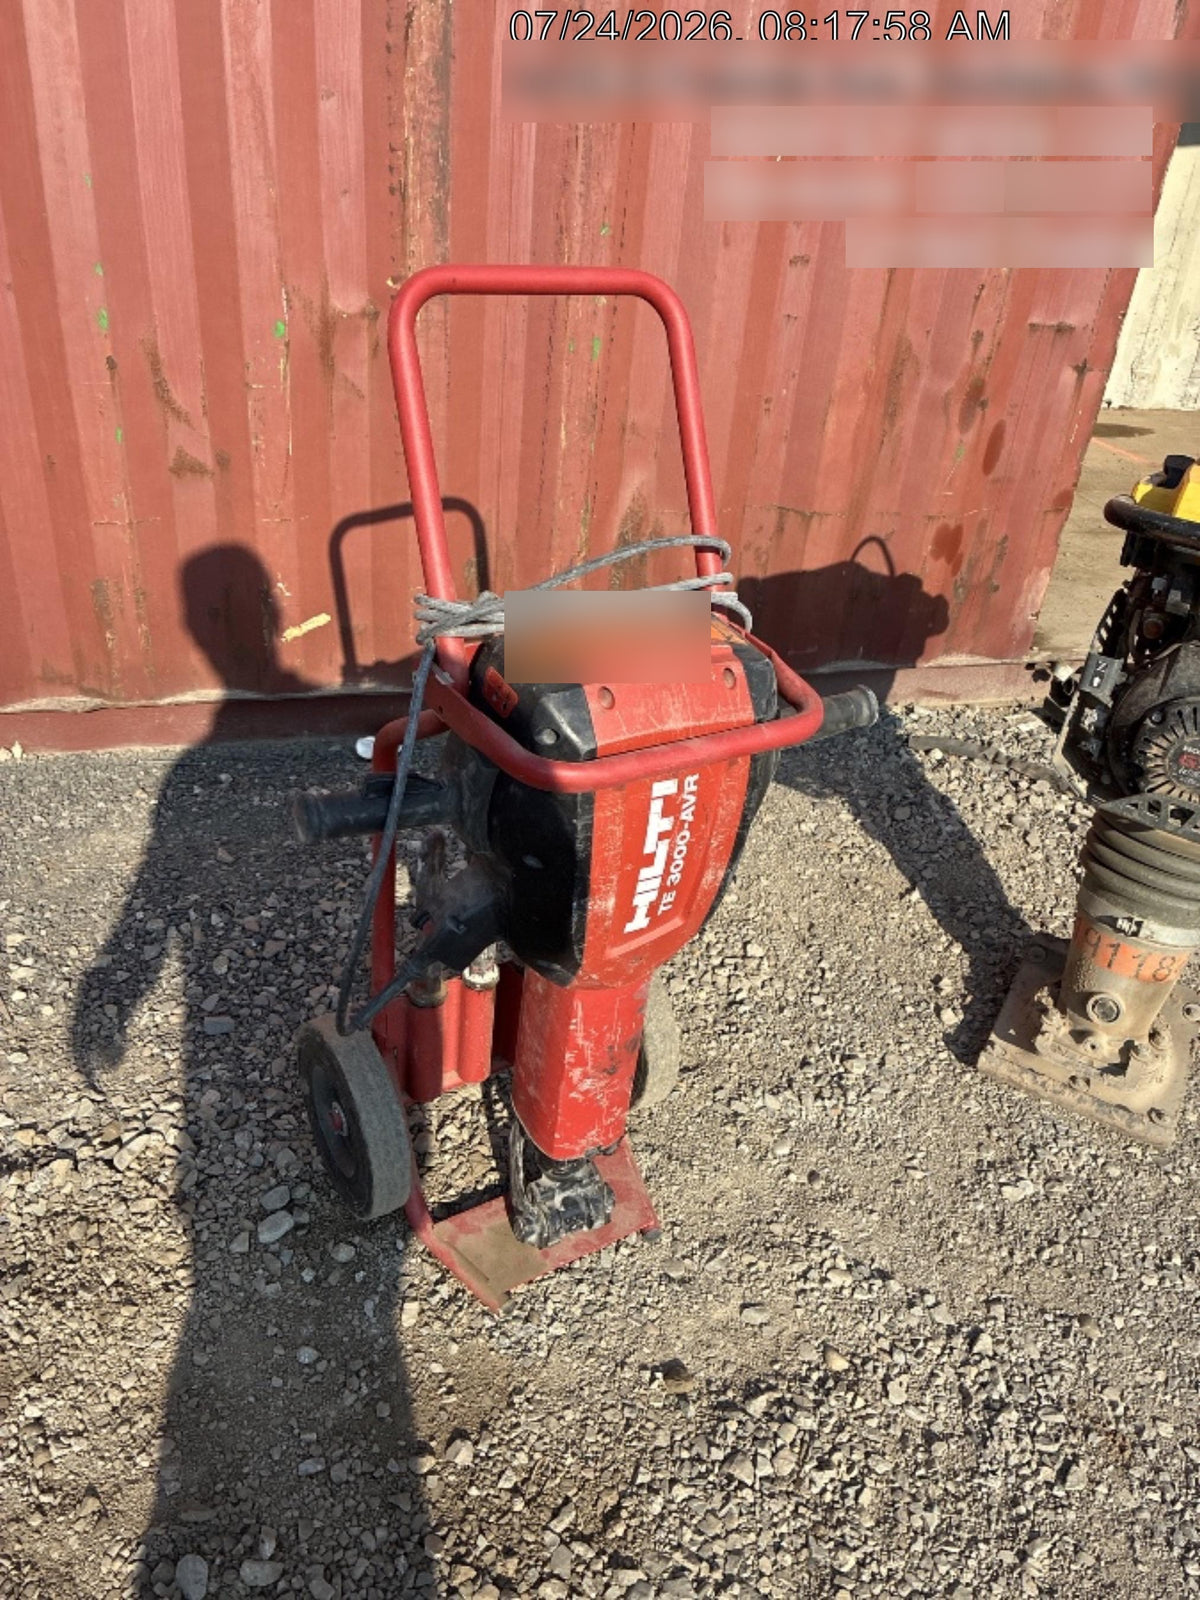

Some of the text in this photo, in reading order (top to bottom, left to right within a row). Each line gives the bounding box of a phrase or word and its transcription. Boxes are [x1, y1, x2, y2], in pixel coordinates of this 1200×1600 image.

[624, 778, 679, 934] HILTI
[657, 773, 699, 916] TE 3000-AVR
